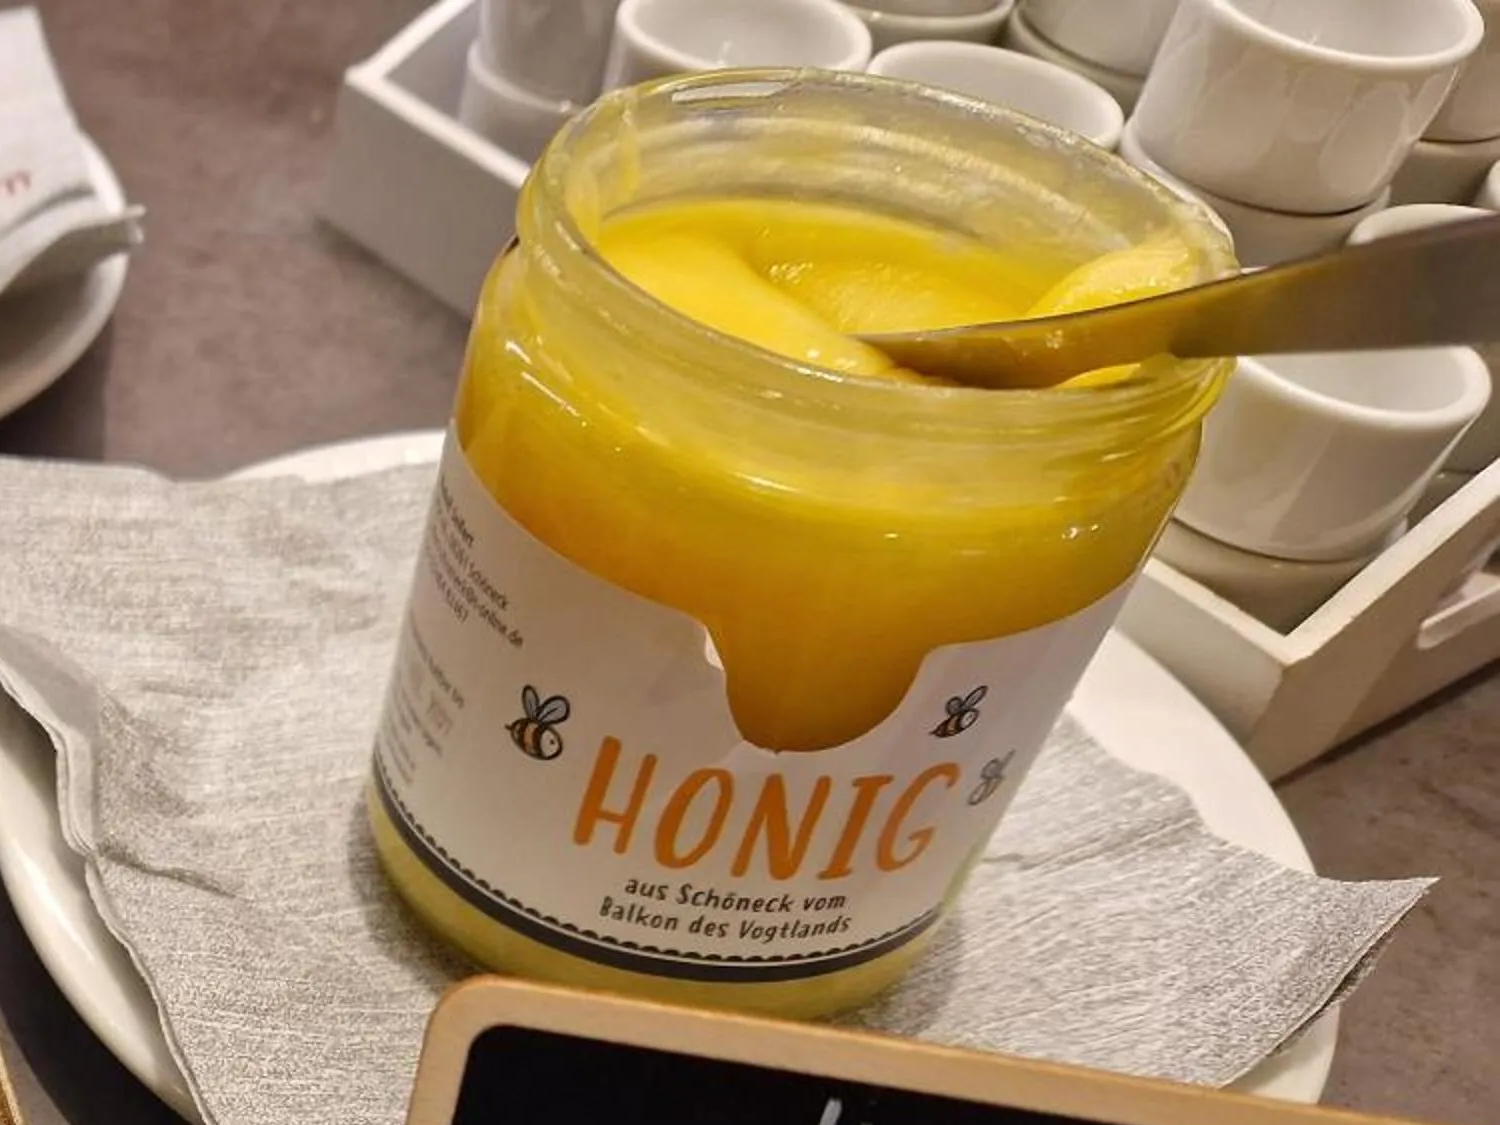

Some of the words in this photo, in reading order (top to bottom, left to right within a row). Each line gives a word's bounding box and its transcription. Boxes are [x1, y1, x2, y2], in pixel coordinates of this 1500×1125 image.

[572, 735, 961, 882] HONIG
[599, 895, 679, 932] Balkon
[687, 915, 730, 939] des
[738, 915, 853, 945] Vogtlands
[624, 878, 669, 901] aus
[675, 883, 795, 913] Schöneck
[802, 894, 847, 912] vom
